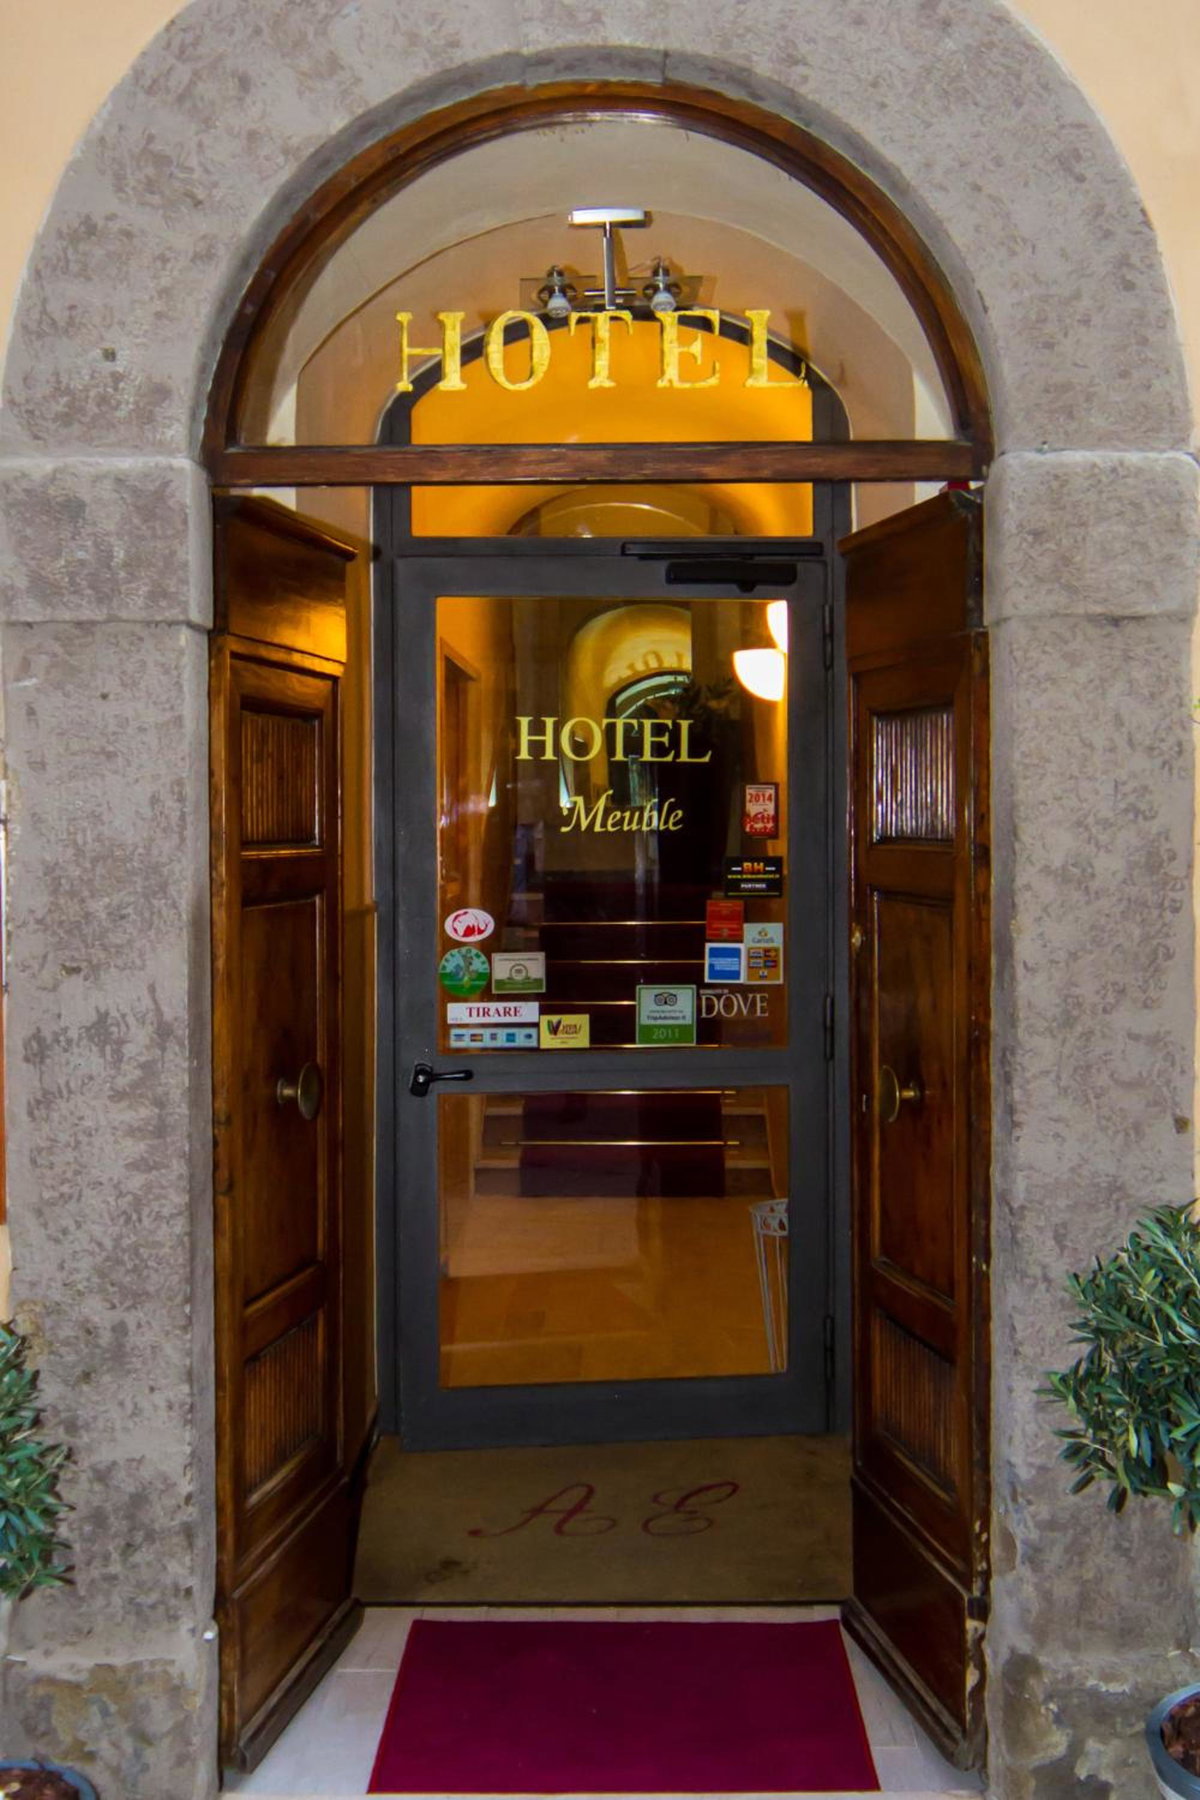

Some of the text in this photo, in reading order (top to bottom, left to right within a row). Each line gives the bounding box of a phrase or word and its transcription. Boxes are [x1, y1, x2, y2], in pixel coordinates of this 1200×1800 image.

[396, 309, 808, 392] HOTEL
[515, 716, 712, 763] HOTEL
[560, 789, 684, 833] Meuble
[748, 792, 773, 804] 2014
[466, 1005, 523, 1018] TIRARE
[700, 992, 769, 1018] DOVE
[652, 1028, 680, 1039] 2011
